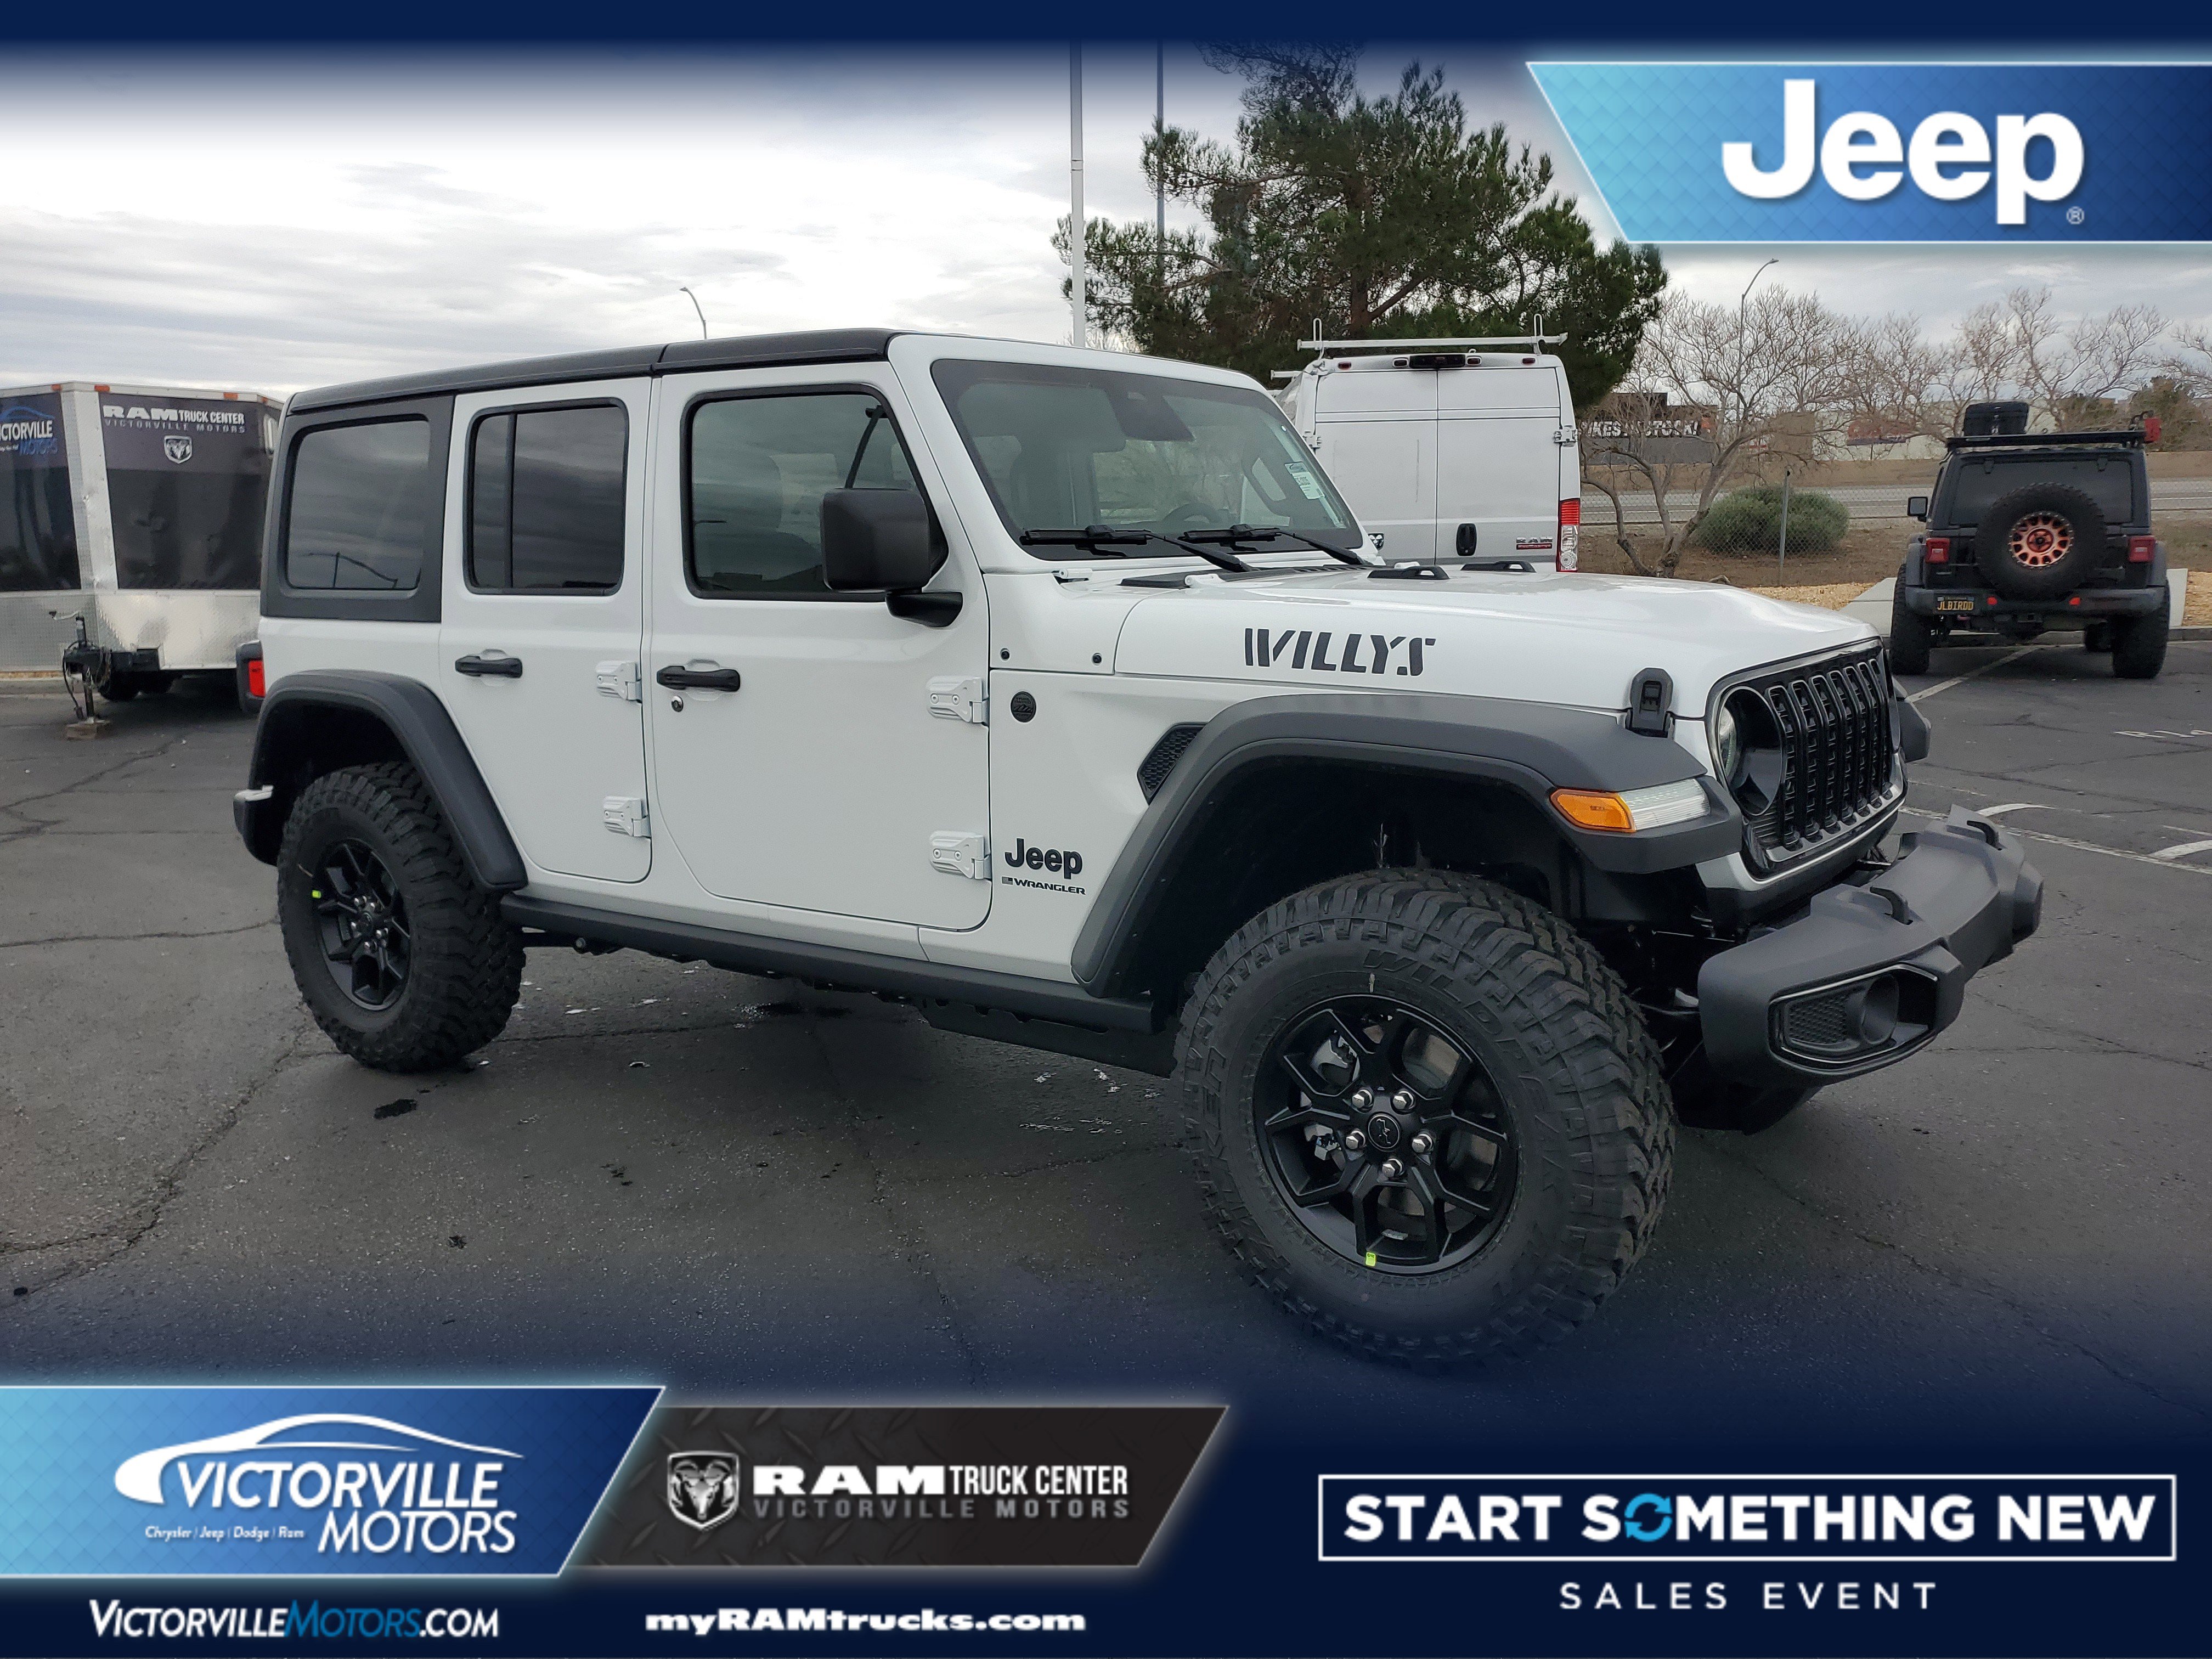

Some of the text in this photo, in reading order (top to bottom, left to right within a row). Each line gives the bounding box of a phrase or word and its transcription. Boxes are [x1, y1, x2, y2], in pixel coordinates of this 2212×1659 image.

[103, 405, 245, 425] RAM TRUCK CENTER
[105, 419, 246, 434] VICTORVILLE MOTORS
[1245, 628, 1436, 676] WILLYS
[1005, 838, 1082, 879] Jeep
[1013, 878, 1086, 895] WRANGLER
